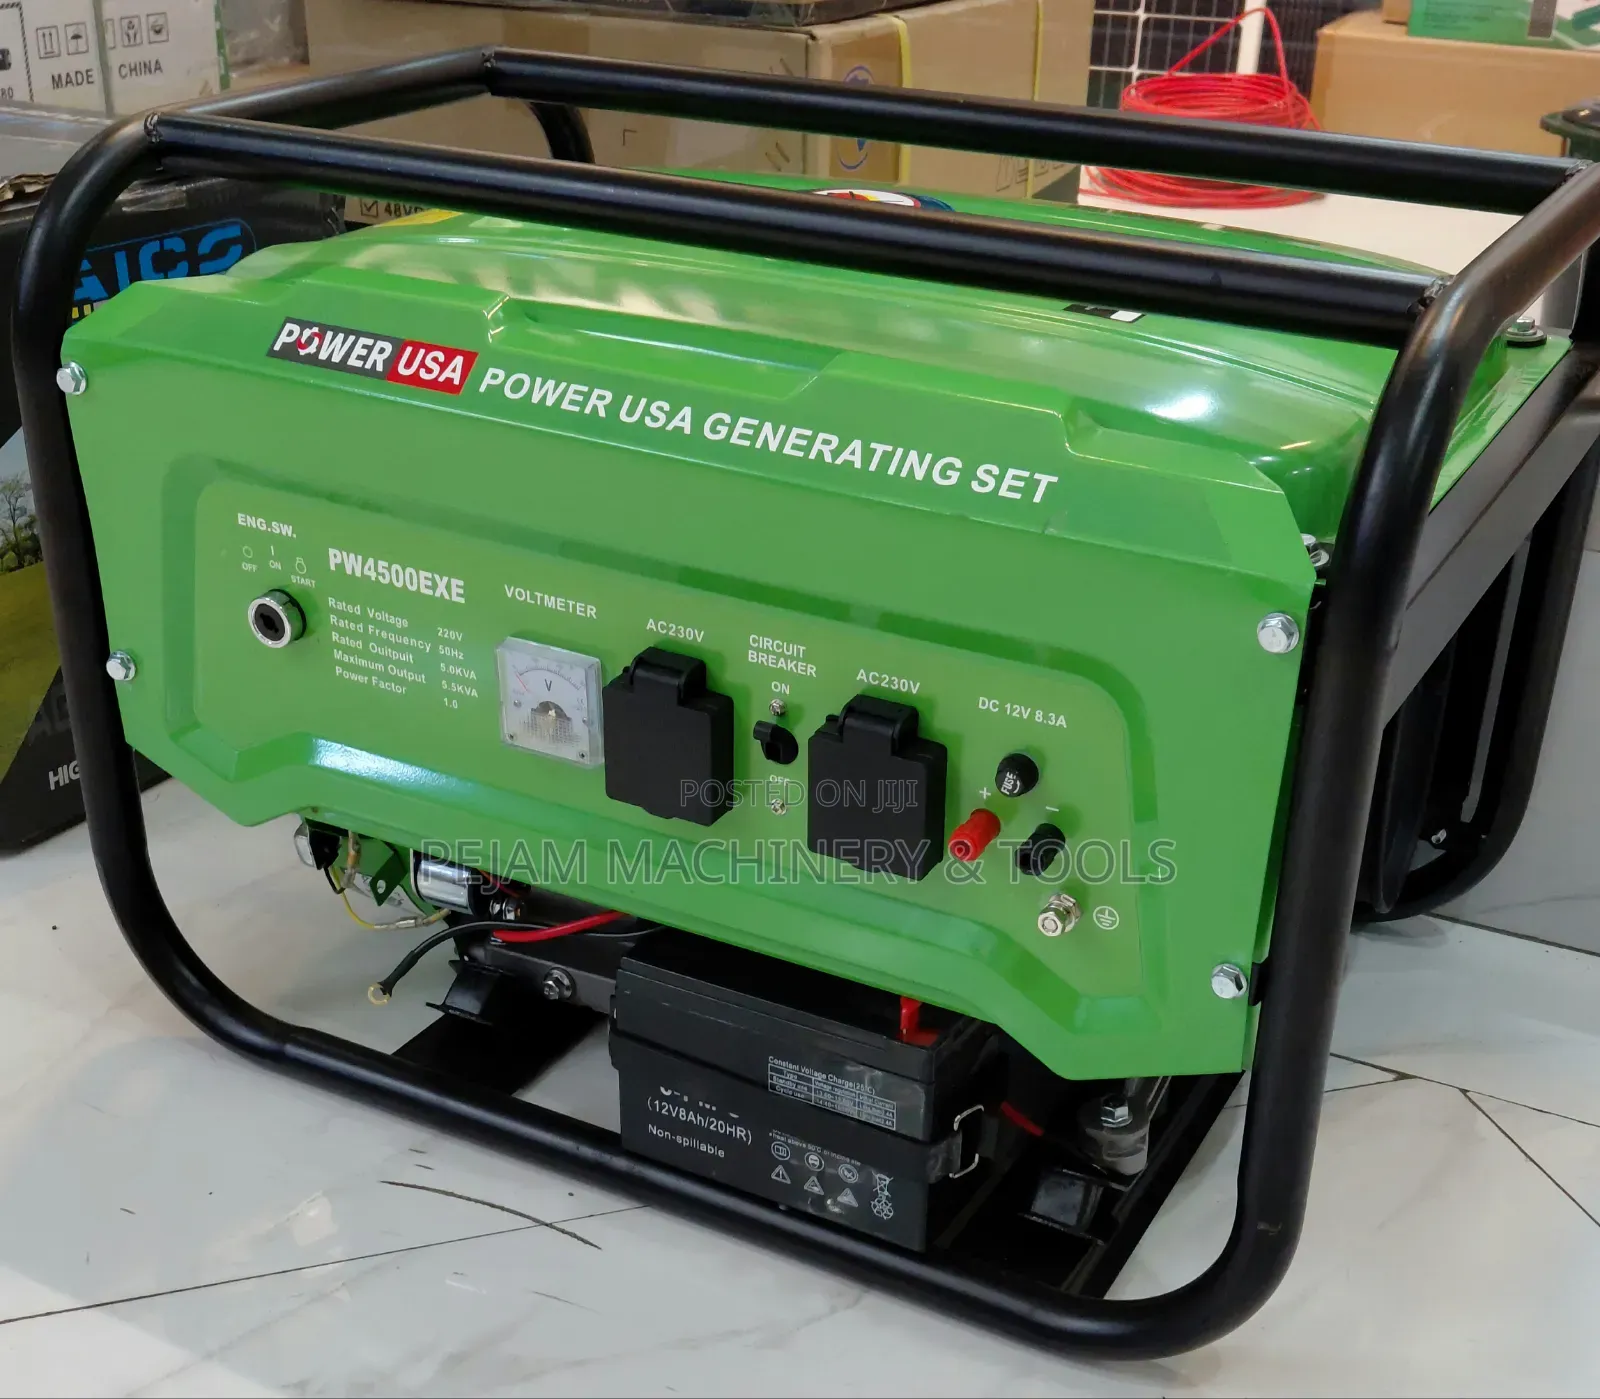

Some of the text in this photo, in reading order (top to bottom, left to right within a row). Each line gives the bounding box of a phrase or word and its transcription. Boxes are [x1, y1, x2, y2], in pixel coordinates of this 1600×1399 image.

[51, 58, 163, 91] MADE CHINA
[273, 322, 465, 386] POWER USA
[479, 367, 1058, 504] POWER USA GENERATING SET
[237, 513, 297, 538] ENG.SW.
[241, 559, 316, 588] OFF ON START
[328, 548, 465, 604] PW4500EXE
[504, 584, 597, 619] VOLTMETER
[328, 597, 463, 642] Rated Voltage 220V
[646, 618, 705, 643] AC230V
[330, 614, 464, 660] Rated Frequency 50Hz
[749, 634, 806, 659] CIRCUIT
[331, 631, 363, 649] Rated
[440, 662, 477, 681] 5.0KVA
[748, 649, 817, 678] BREAKER
[333, 649, 479, 698] Maximum Output 5.5KVA
[335, 665, 458, 709] Power Factor 1.0
[544, 679, 553, 691] V
[771, 681, 790, 695] ON
[856, 668, 921, 695] AC230V
[978, 696, 1067, 729] DC 12V 8.3A
[1000, 771, 1016, 795] FUSE
[768, 1055, 800, 1072] Constant
[647, 1096, 752, 1146] (12V8Ah/20HR)
[648, 1123, 725, 1158] Non-spillable
